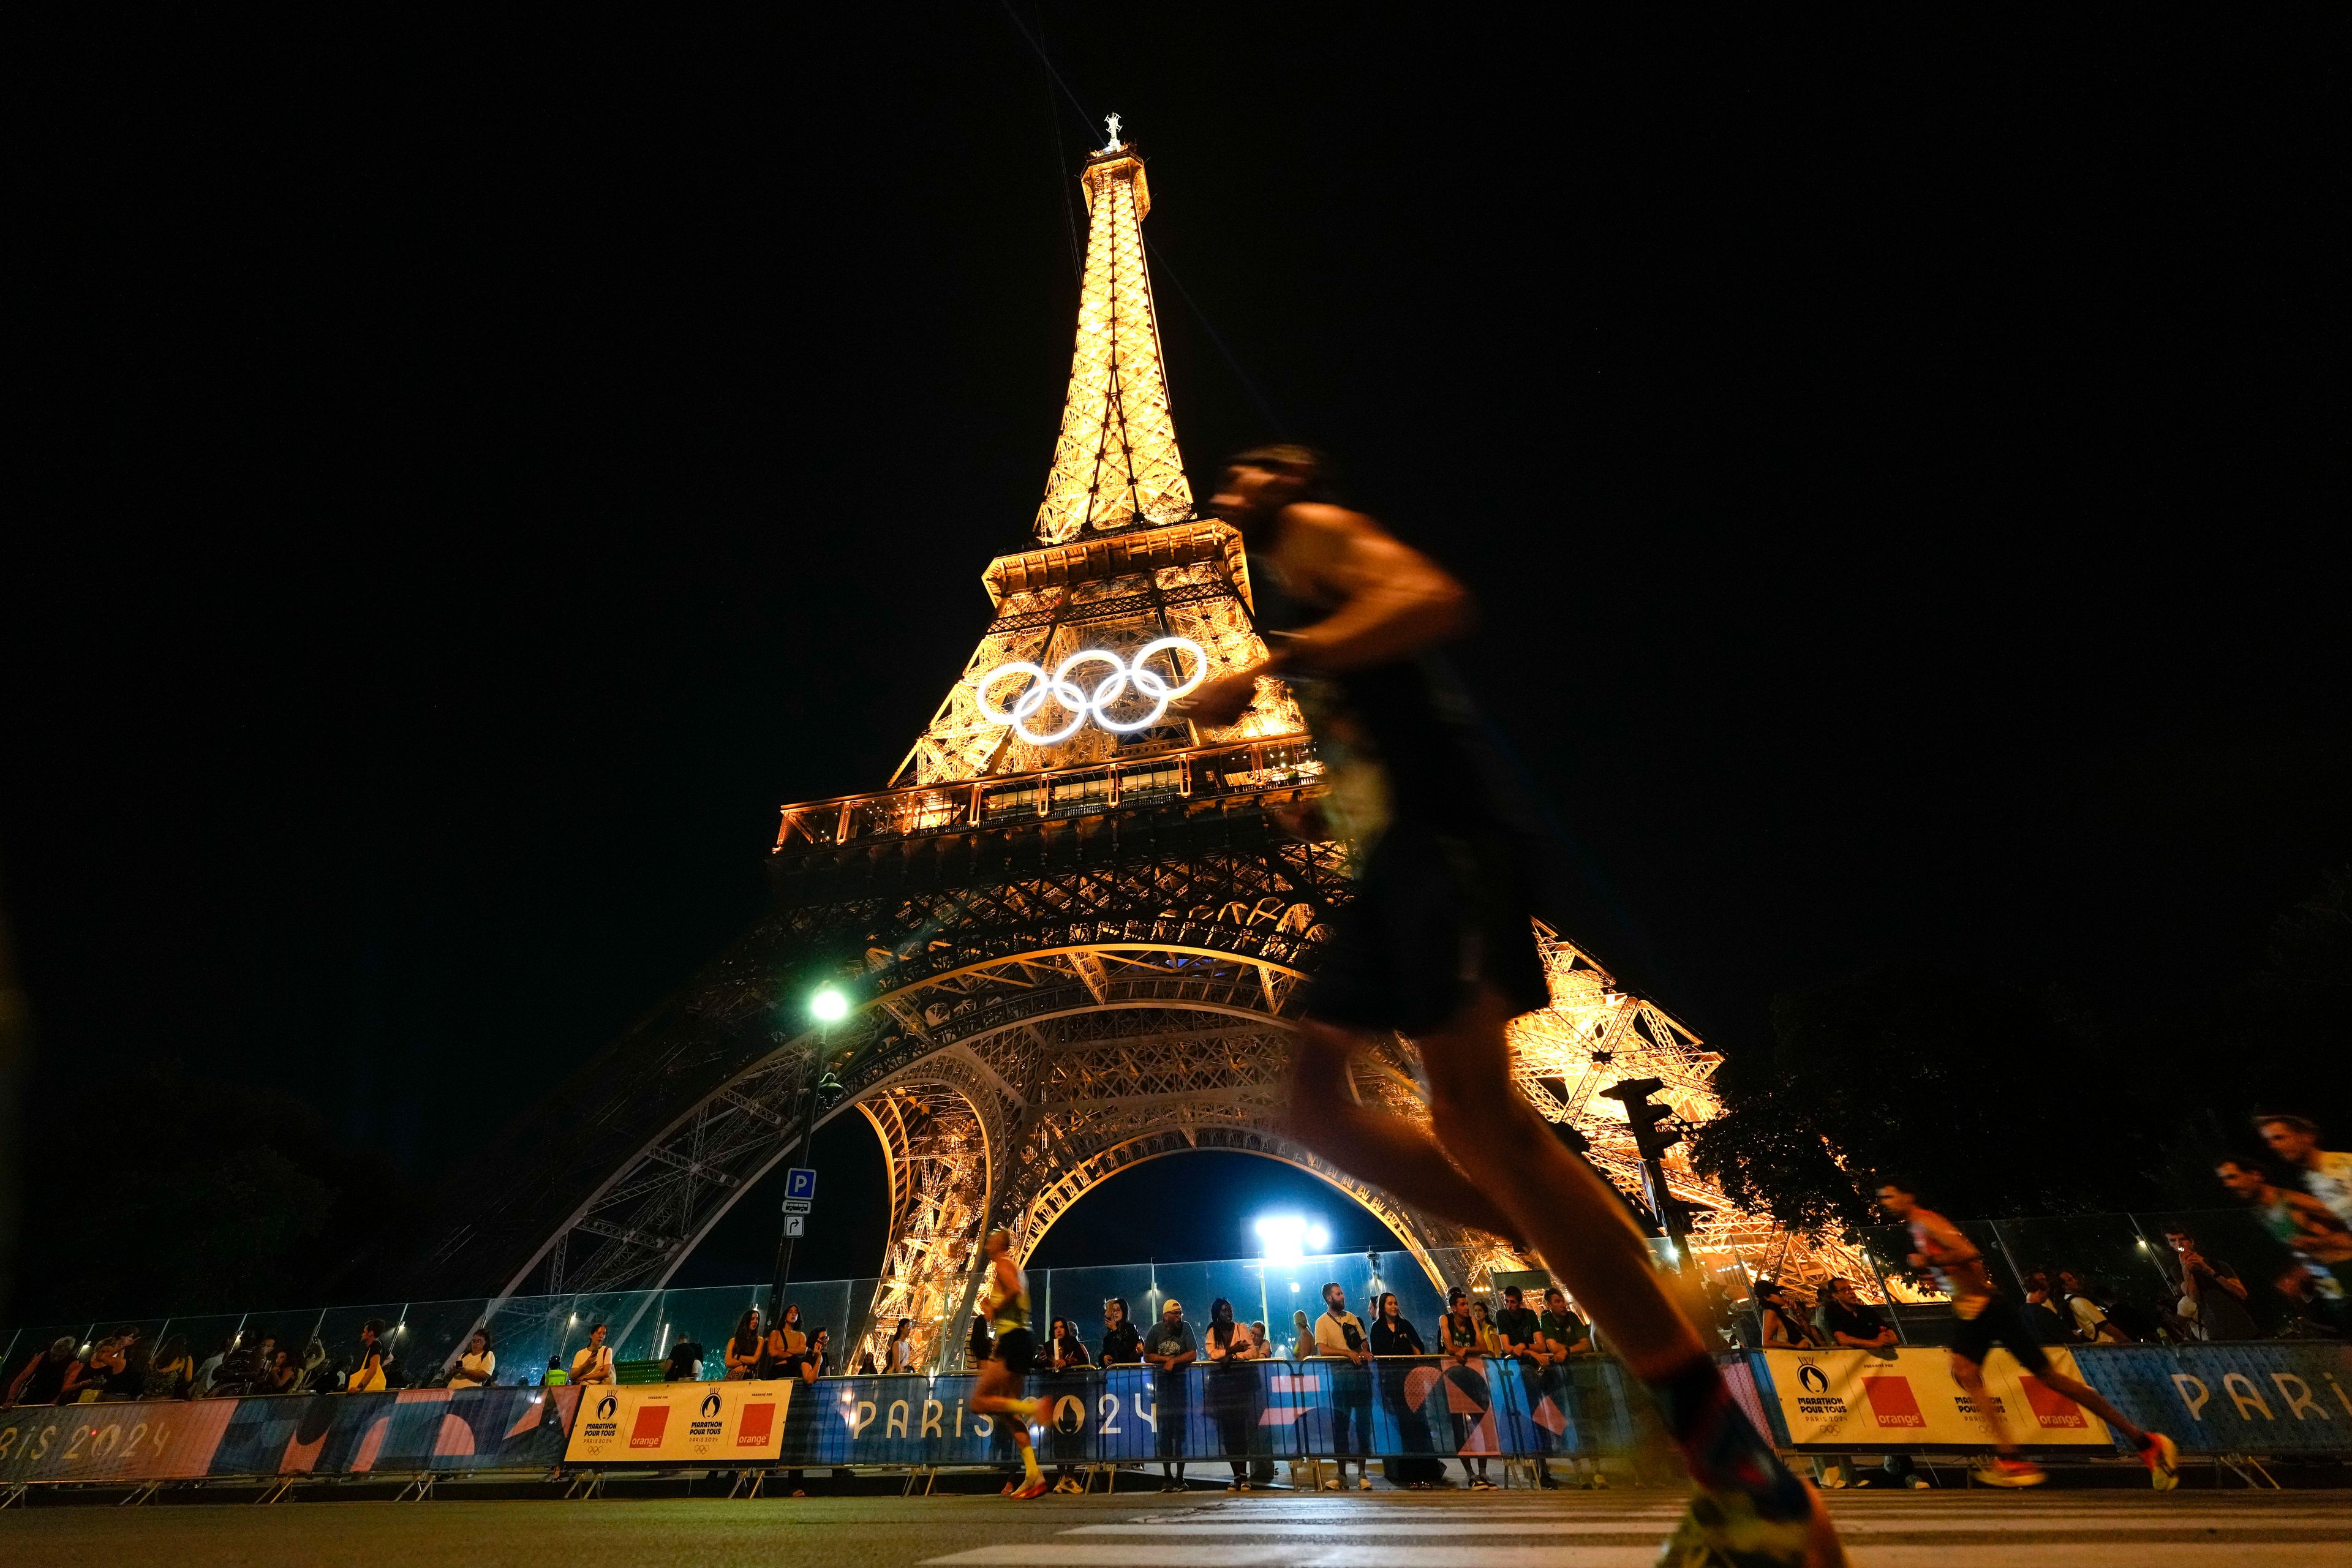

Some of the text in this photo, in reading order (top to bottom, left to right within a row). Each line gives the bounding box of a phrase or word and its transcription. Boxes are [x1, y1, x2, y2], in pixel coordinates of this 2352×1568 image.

[794, 1175, 807, 1193] P
[1878, 1414, 1920, 1427] orange
[2040, 1414, 2081, 1427] orange
[62, 1422, 171, 1460] 2024
[631, 1437, 658, 1447] orange
[739, 1436, 766, 1445] orange
